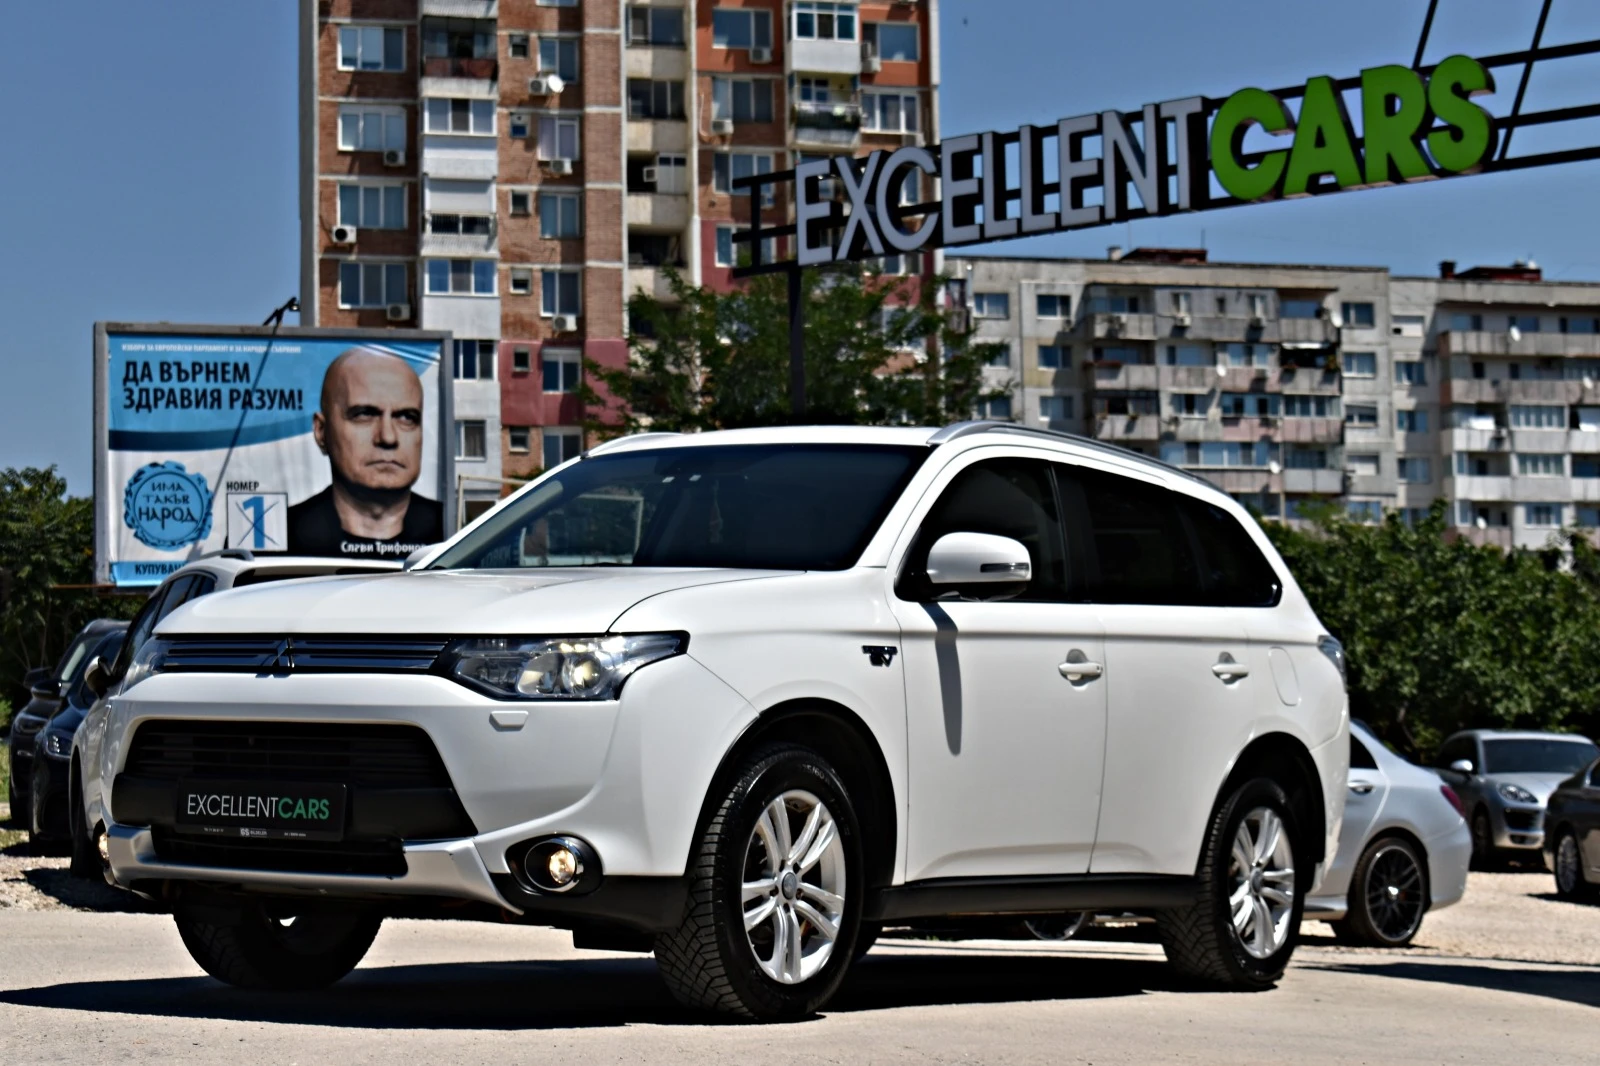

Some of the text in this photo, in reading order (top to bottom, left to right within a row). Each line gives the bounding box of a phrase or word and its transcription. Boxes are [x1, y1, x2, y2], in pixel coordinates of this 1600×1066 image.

[123, 361, 250, 386] ДА ВЪРНЕМ
[123, 388, 303, 413] ЗДРАВИЯ РАЗУМ!
[151, 482, 185, 492] ИМА
[226, 481, 260, 491] НОМЕР
[138, 507, 199, 530] НАРОД
[242, 496, 265, 549] 1
[187, 793, 330, 820] EXCELLENTCARS
